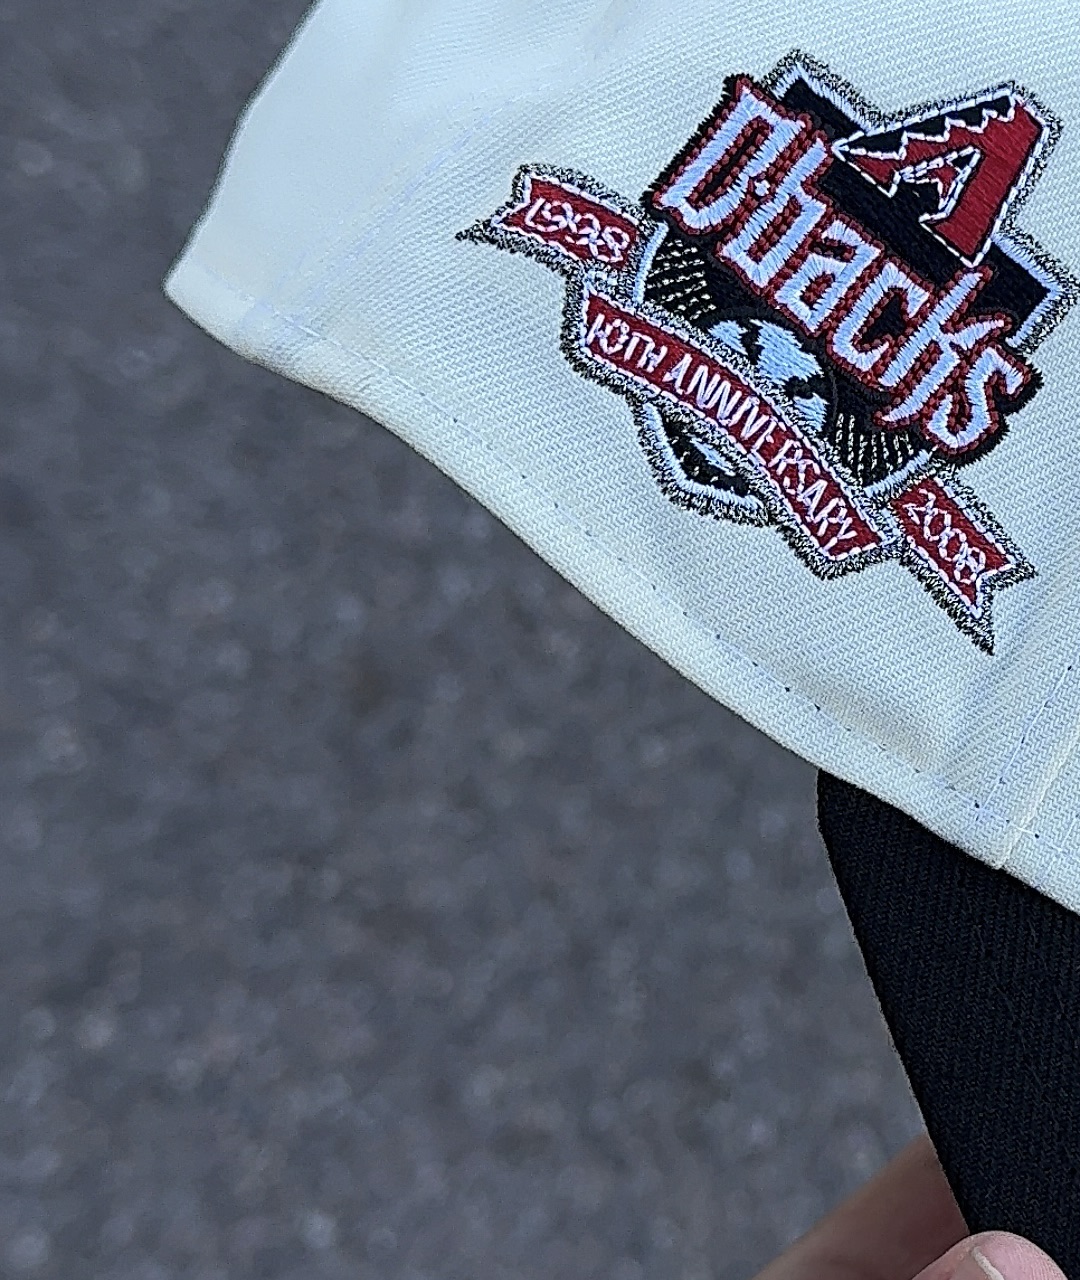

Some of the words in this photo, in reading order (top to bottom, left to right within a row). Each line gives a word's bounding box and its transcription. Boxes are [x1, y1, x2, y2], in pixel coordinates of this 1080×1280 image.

[587, 313, 668, 372] 10TH
[663, 353, 857, 551] ANNIVERSARY
[902, 488, 986, 584] 2008
